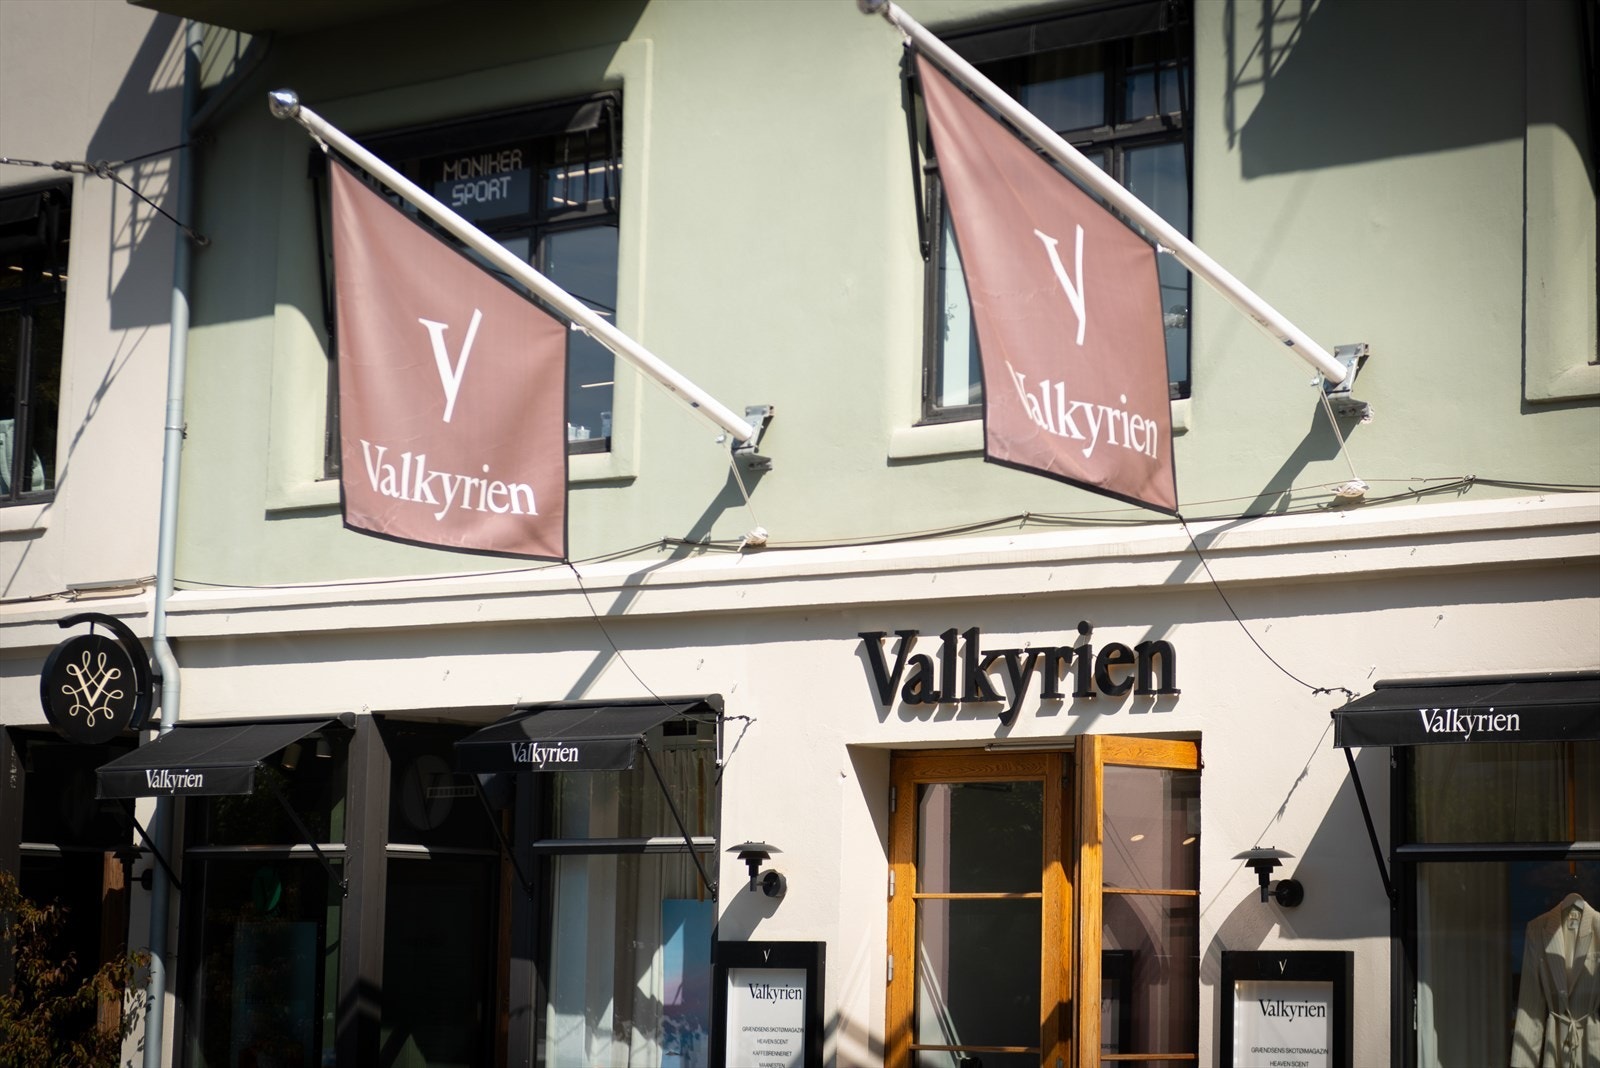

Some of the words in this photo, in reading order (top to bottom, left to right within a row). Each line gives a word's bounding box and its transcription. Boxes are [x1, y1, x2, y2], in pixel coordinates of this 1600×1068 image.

[443, 149, 522, 182] MONIKER
[452, 176, 511, 206] SPORT
[1005, 360, 1158, 459] Valkyrien
[360, 439, 539, 521] Valkyrien
[858, 620, 1181, 727] Valkyrien
[1419, 707, 1521, 740] Valkyrien
[511, 742, 579, 769] Valkyrien
[145, 769, 203, 794] Valkyrien
[748, 983, 802, 1004] Valkyrien
[1259, 999, 1326, 1022] Valkyrien
[1269, 1060, 1291, 1068] HEAVEN
[1291, 1060, 1310, 1068] SCENT
